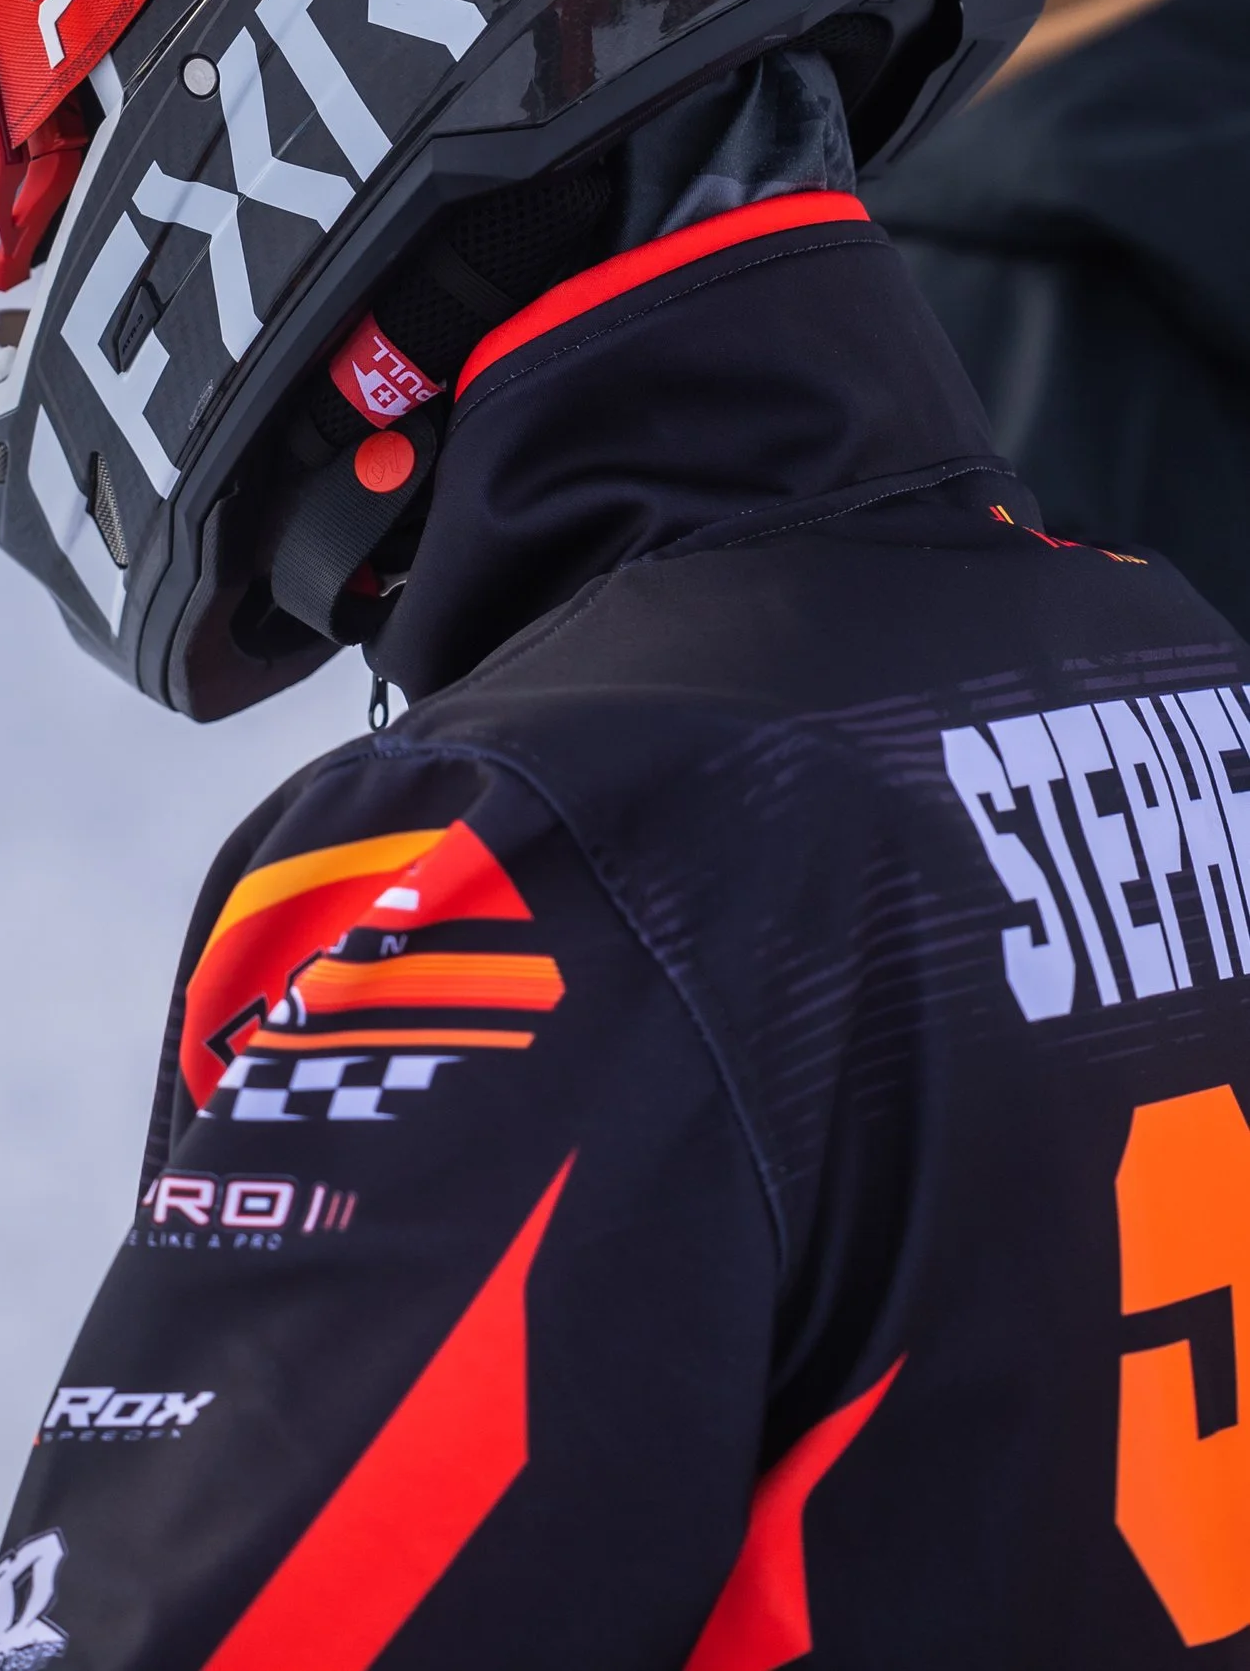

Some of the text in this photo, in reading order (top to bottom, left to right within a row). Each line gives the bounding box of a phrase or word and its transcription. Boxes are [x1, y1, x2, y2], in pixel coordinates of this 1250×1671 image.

[373, 335, 440, 402] PULL
[941, 684, 1250, 1023] STEPHE
[143, 1176, 295, 1227] RO
[207, 1233, 222, 1249] A
[43, 1386, 216, 1428] ROX
